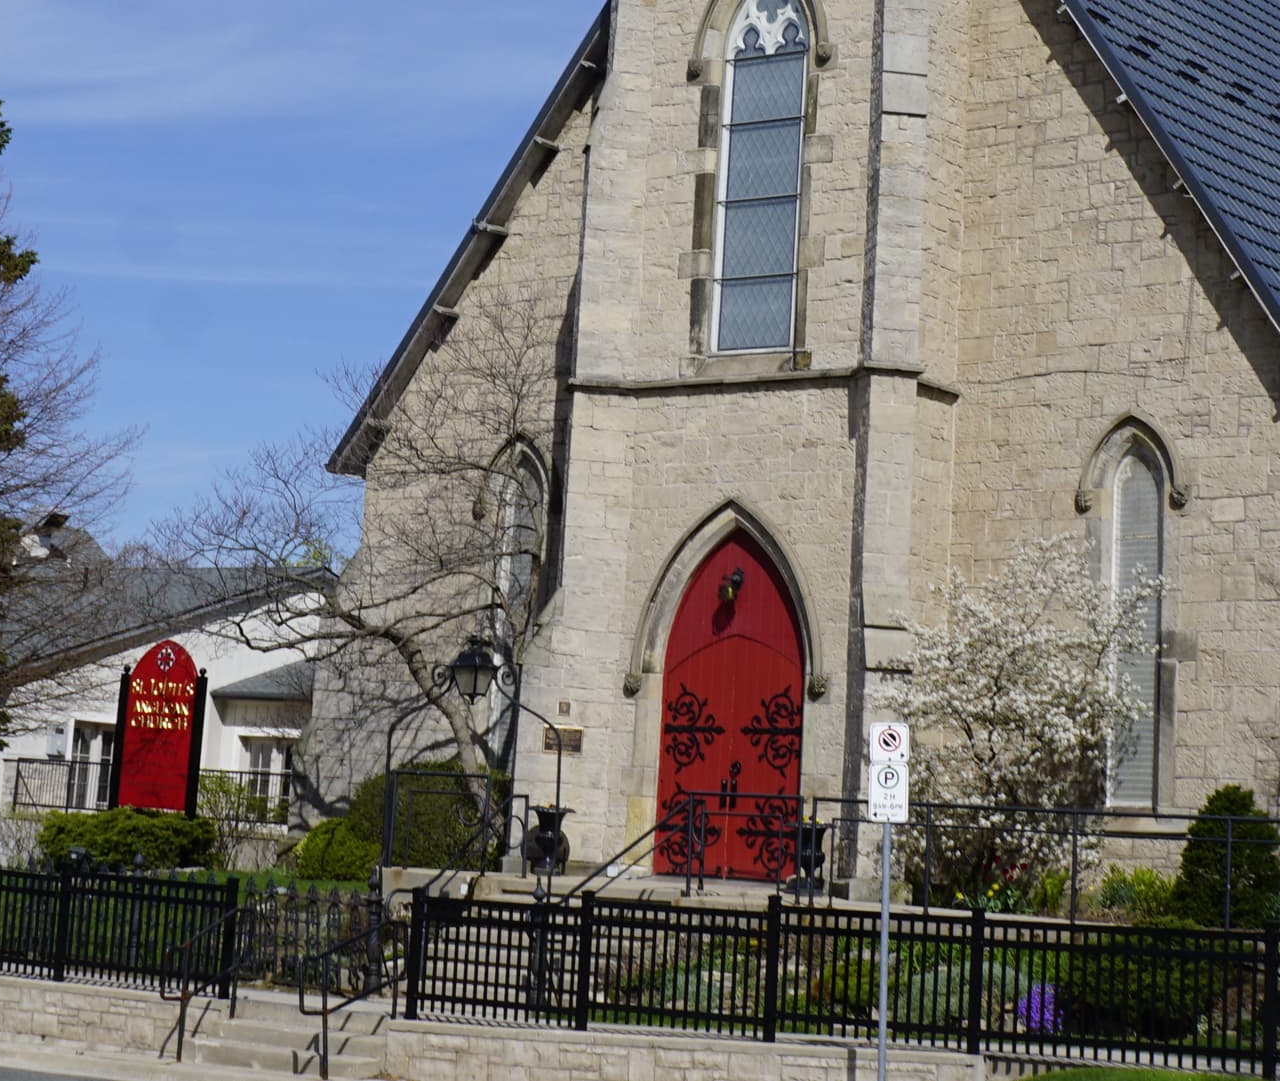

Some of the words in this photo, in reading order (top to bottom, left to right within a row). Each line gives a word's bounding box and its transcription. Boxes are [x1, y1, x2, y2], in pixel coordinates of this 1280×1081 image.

[134, 700, 189, 716] ANGLICAN
[131, 716, 188, 731] CHURCH
[884, 771, 895, 785] P
